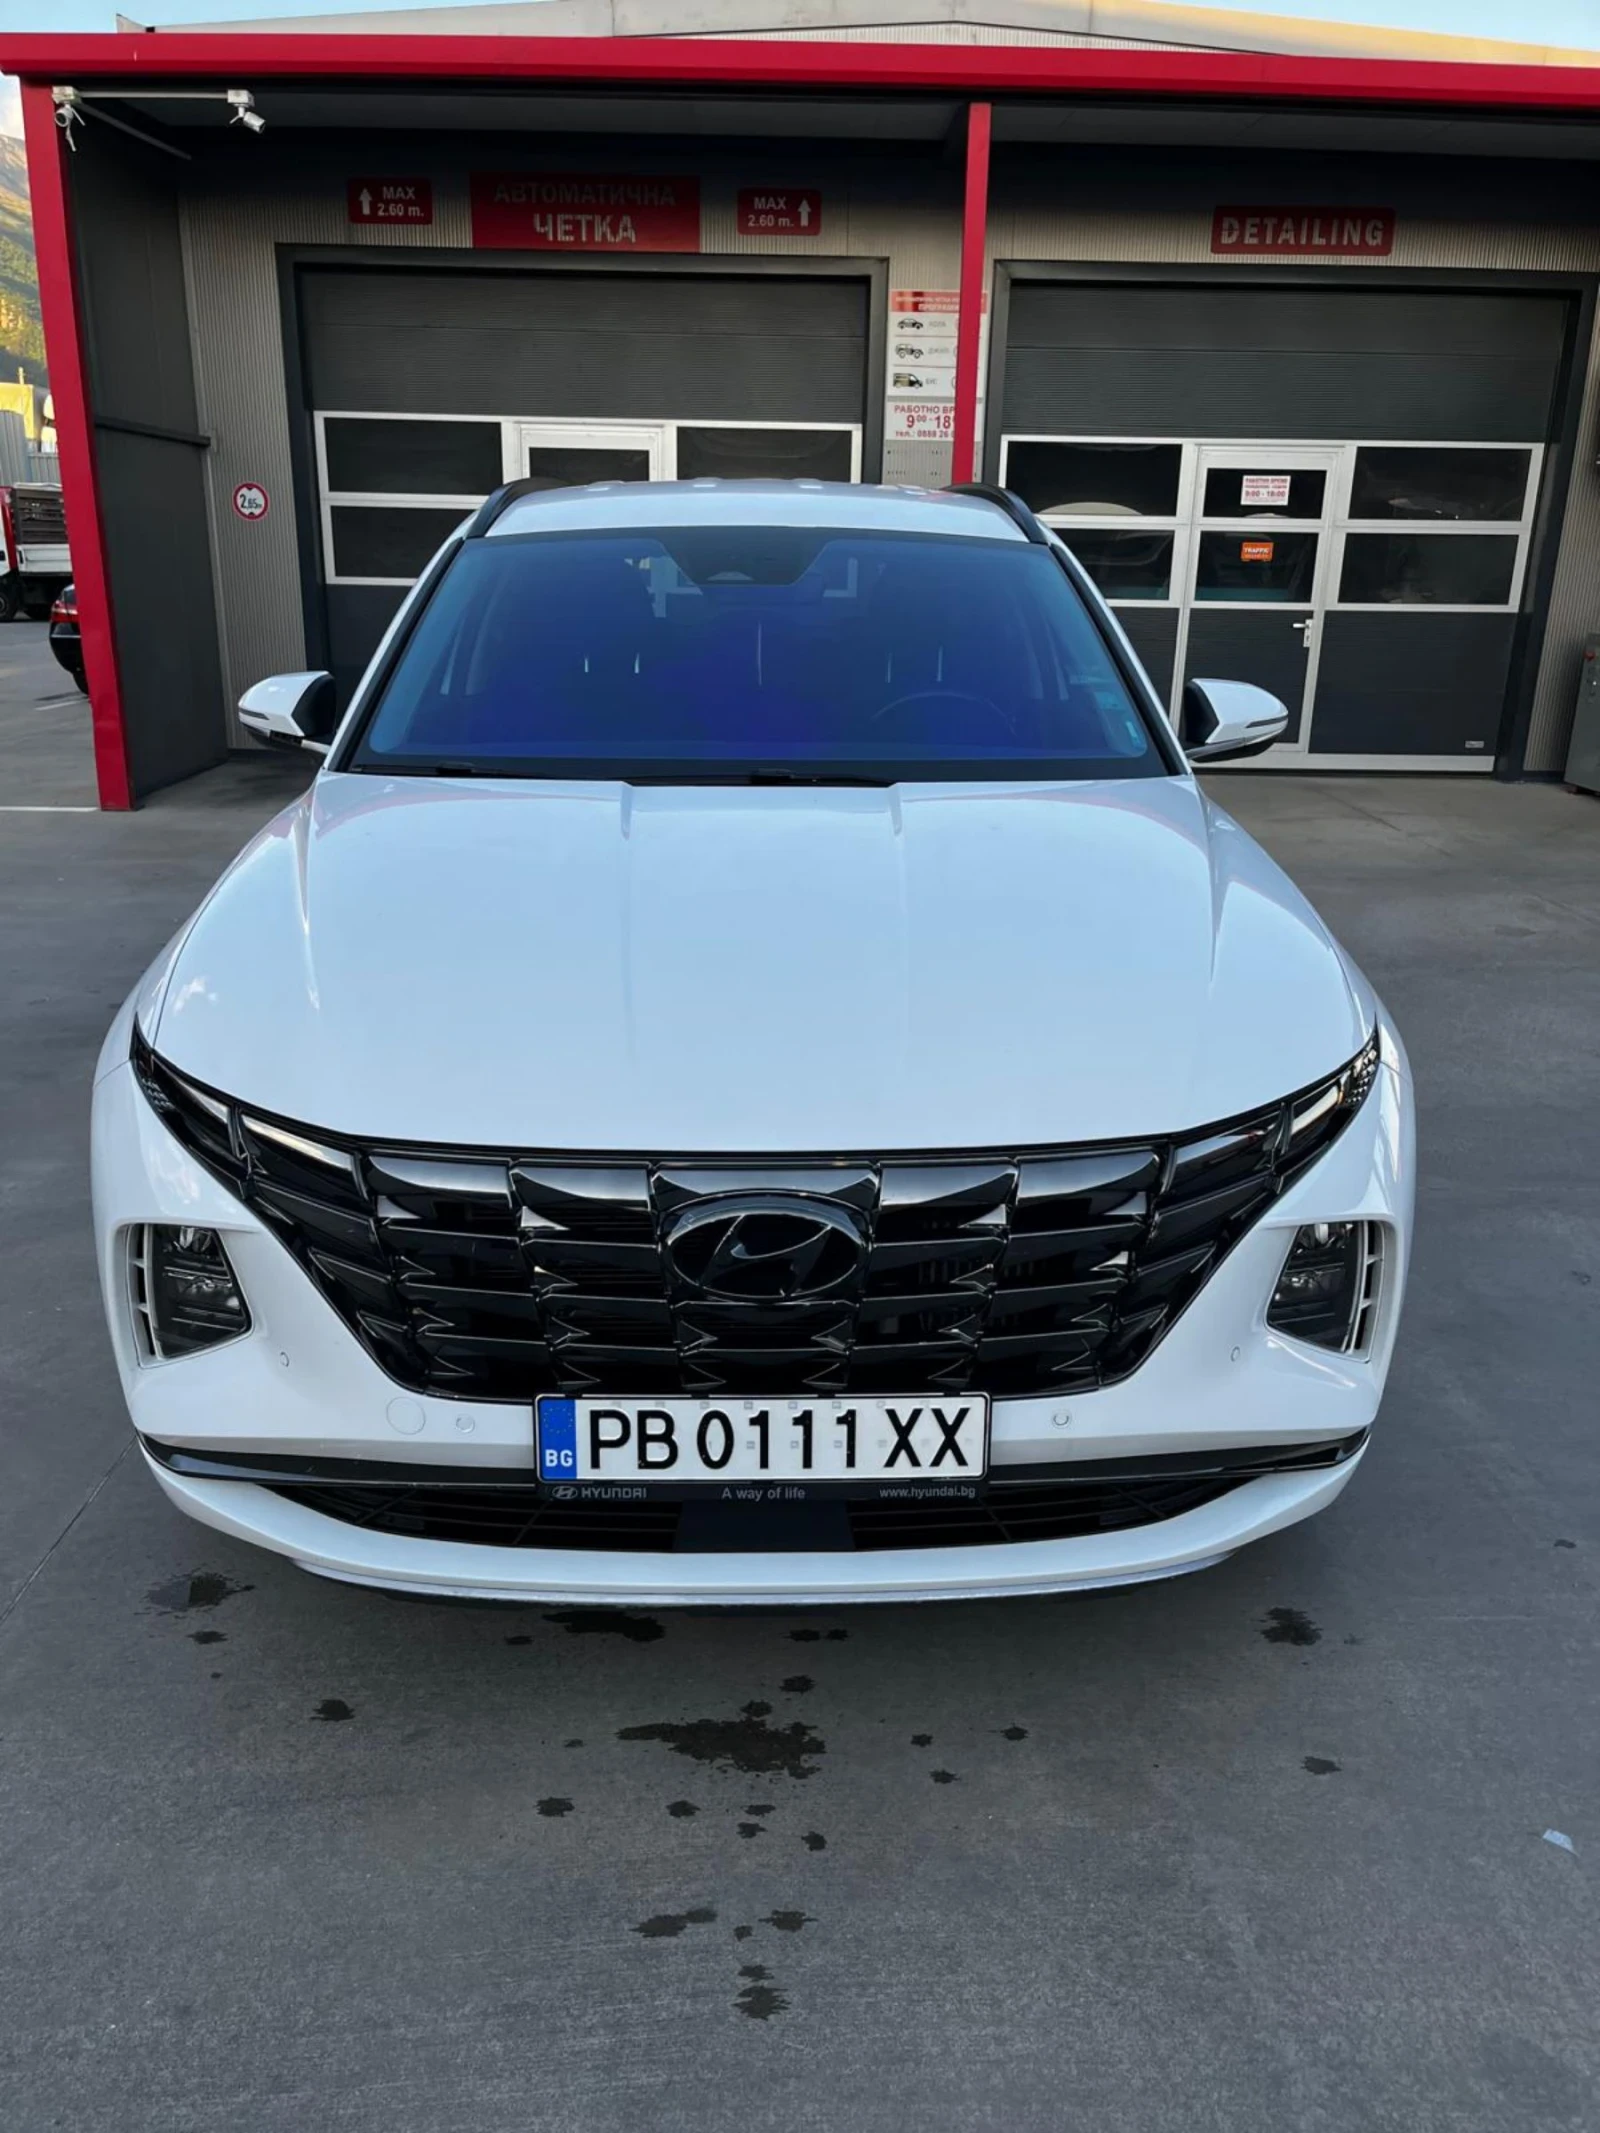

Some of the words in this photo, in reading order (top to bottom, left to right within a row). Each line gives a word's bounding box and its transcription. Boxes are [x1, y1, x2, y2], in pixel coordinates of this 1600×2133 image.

[382, 185, 416, 200] MAX
[493, 182, 677, 207] АВТОМАТИЧНА
[377, 202, 405, 217] 2.60
[753, 196, 787, 211] MAX
[533, 212, 637, 244] ЧЕТКА
[747, 213, 775, 228] 2.60
[1220, 216, 1385, 247] DETAILING
[894, 404, 940, 414] РАБОТНО
[589, 1409, 679, 1470] PB
[696, 1408, 857, 1470] 0111
[882, 1407, 971, 1468] XX
[544, 1449, 574, 1468] BG
[580, 1486, 648, 1499] HYUNDAI
[721, 1487, 733, 1499] A
[735, 1488, 764, 1502] way
[766, 1486, 782, 1499] of
[784, 1486, 807, 1500] life
[879, 1485, 977, 1500] www.hyundai.bg
